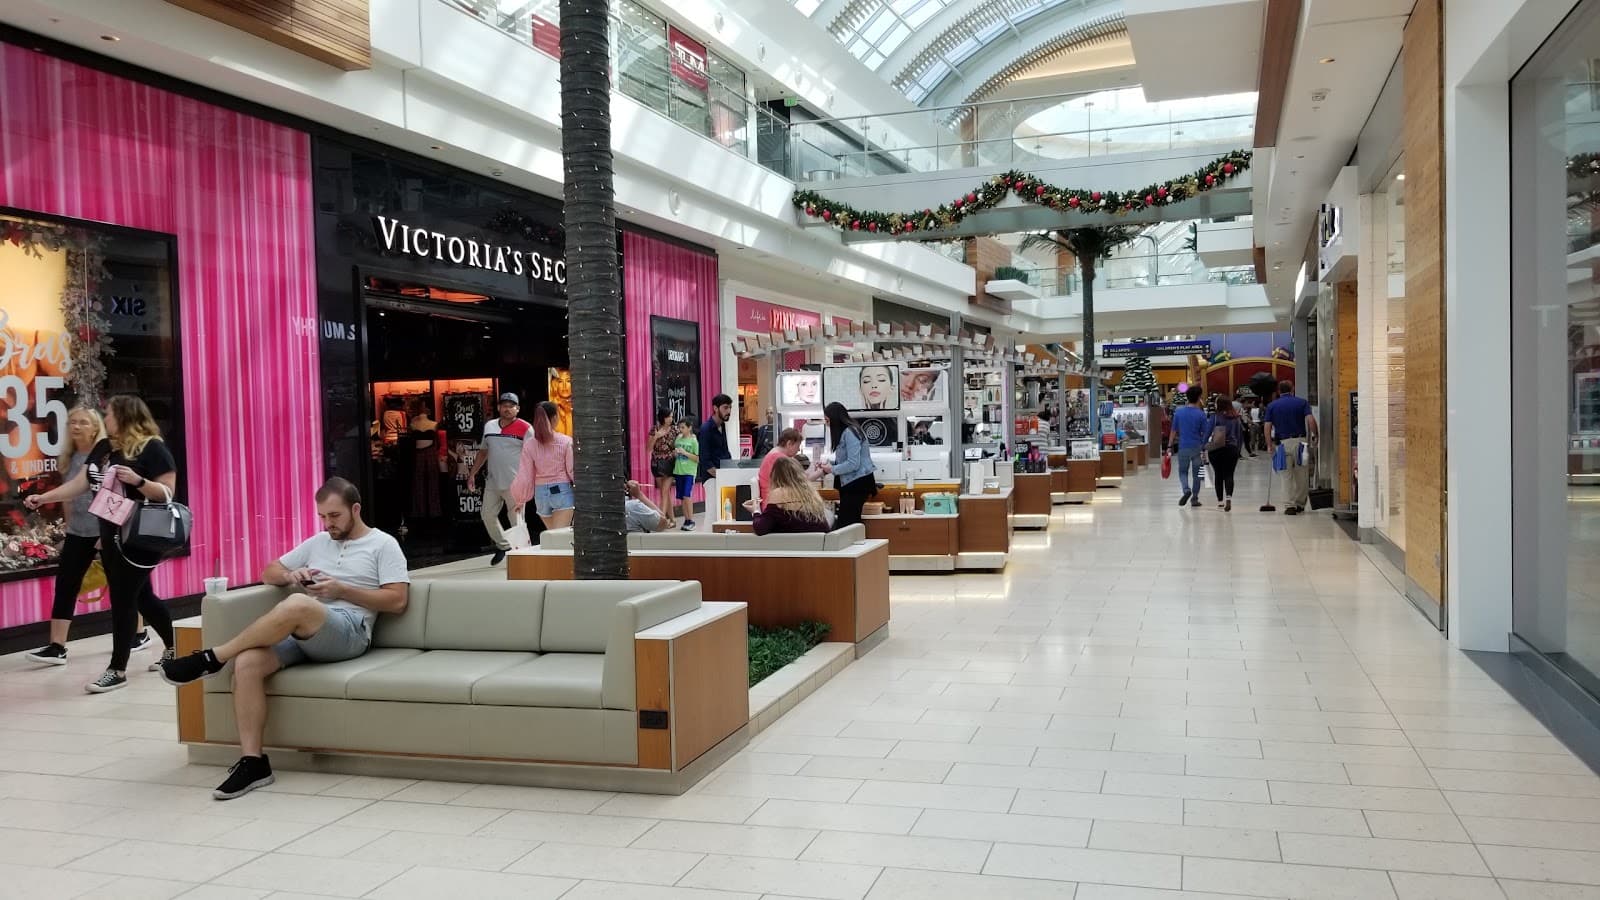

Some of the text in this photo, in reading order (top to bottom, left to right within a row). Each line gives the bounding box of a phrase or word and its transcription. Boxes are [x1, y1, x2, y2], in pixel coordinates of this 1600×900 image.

[377, 215, 523, 276] VICTORIA'S
[771, 308, 797, 331] PINK
[0, 375, 68, 458] 35
[22, 458, 58, 474] UNDER
